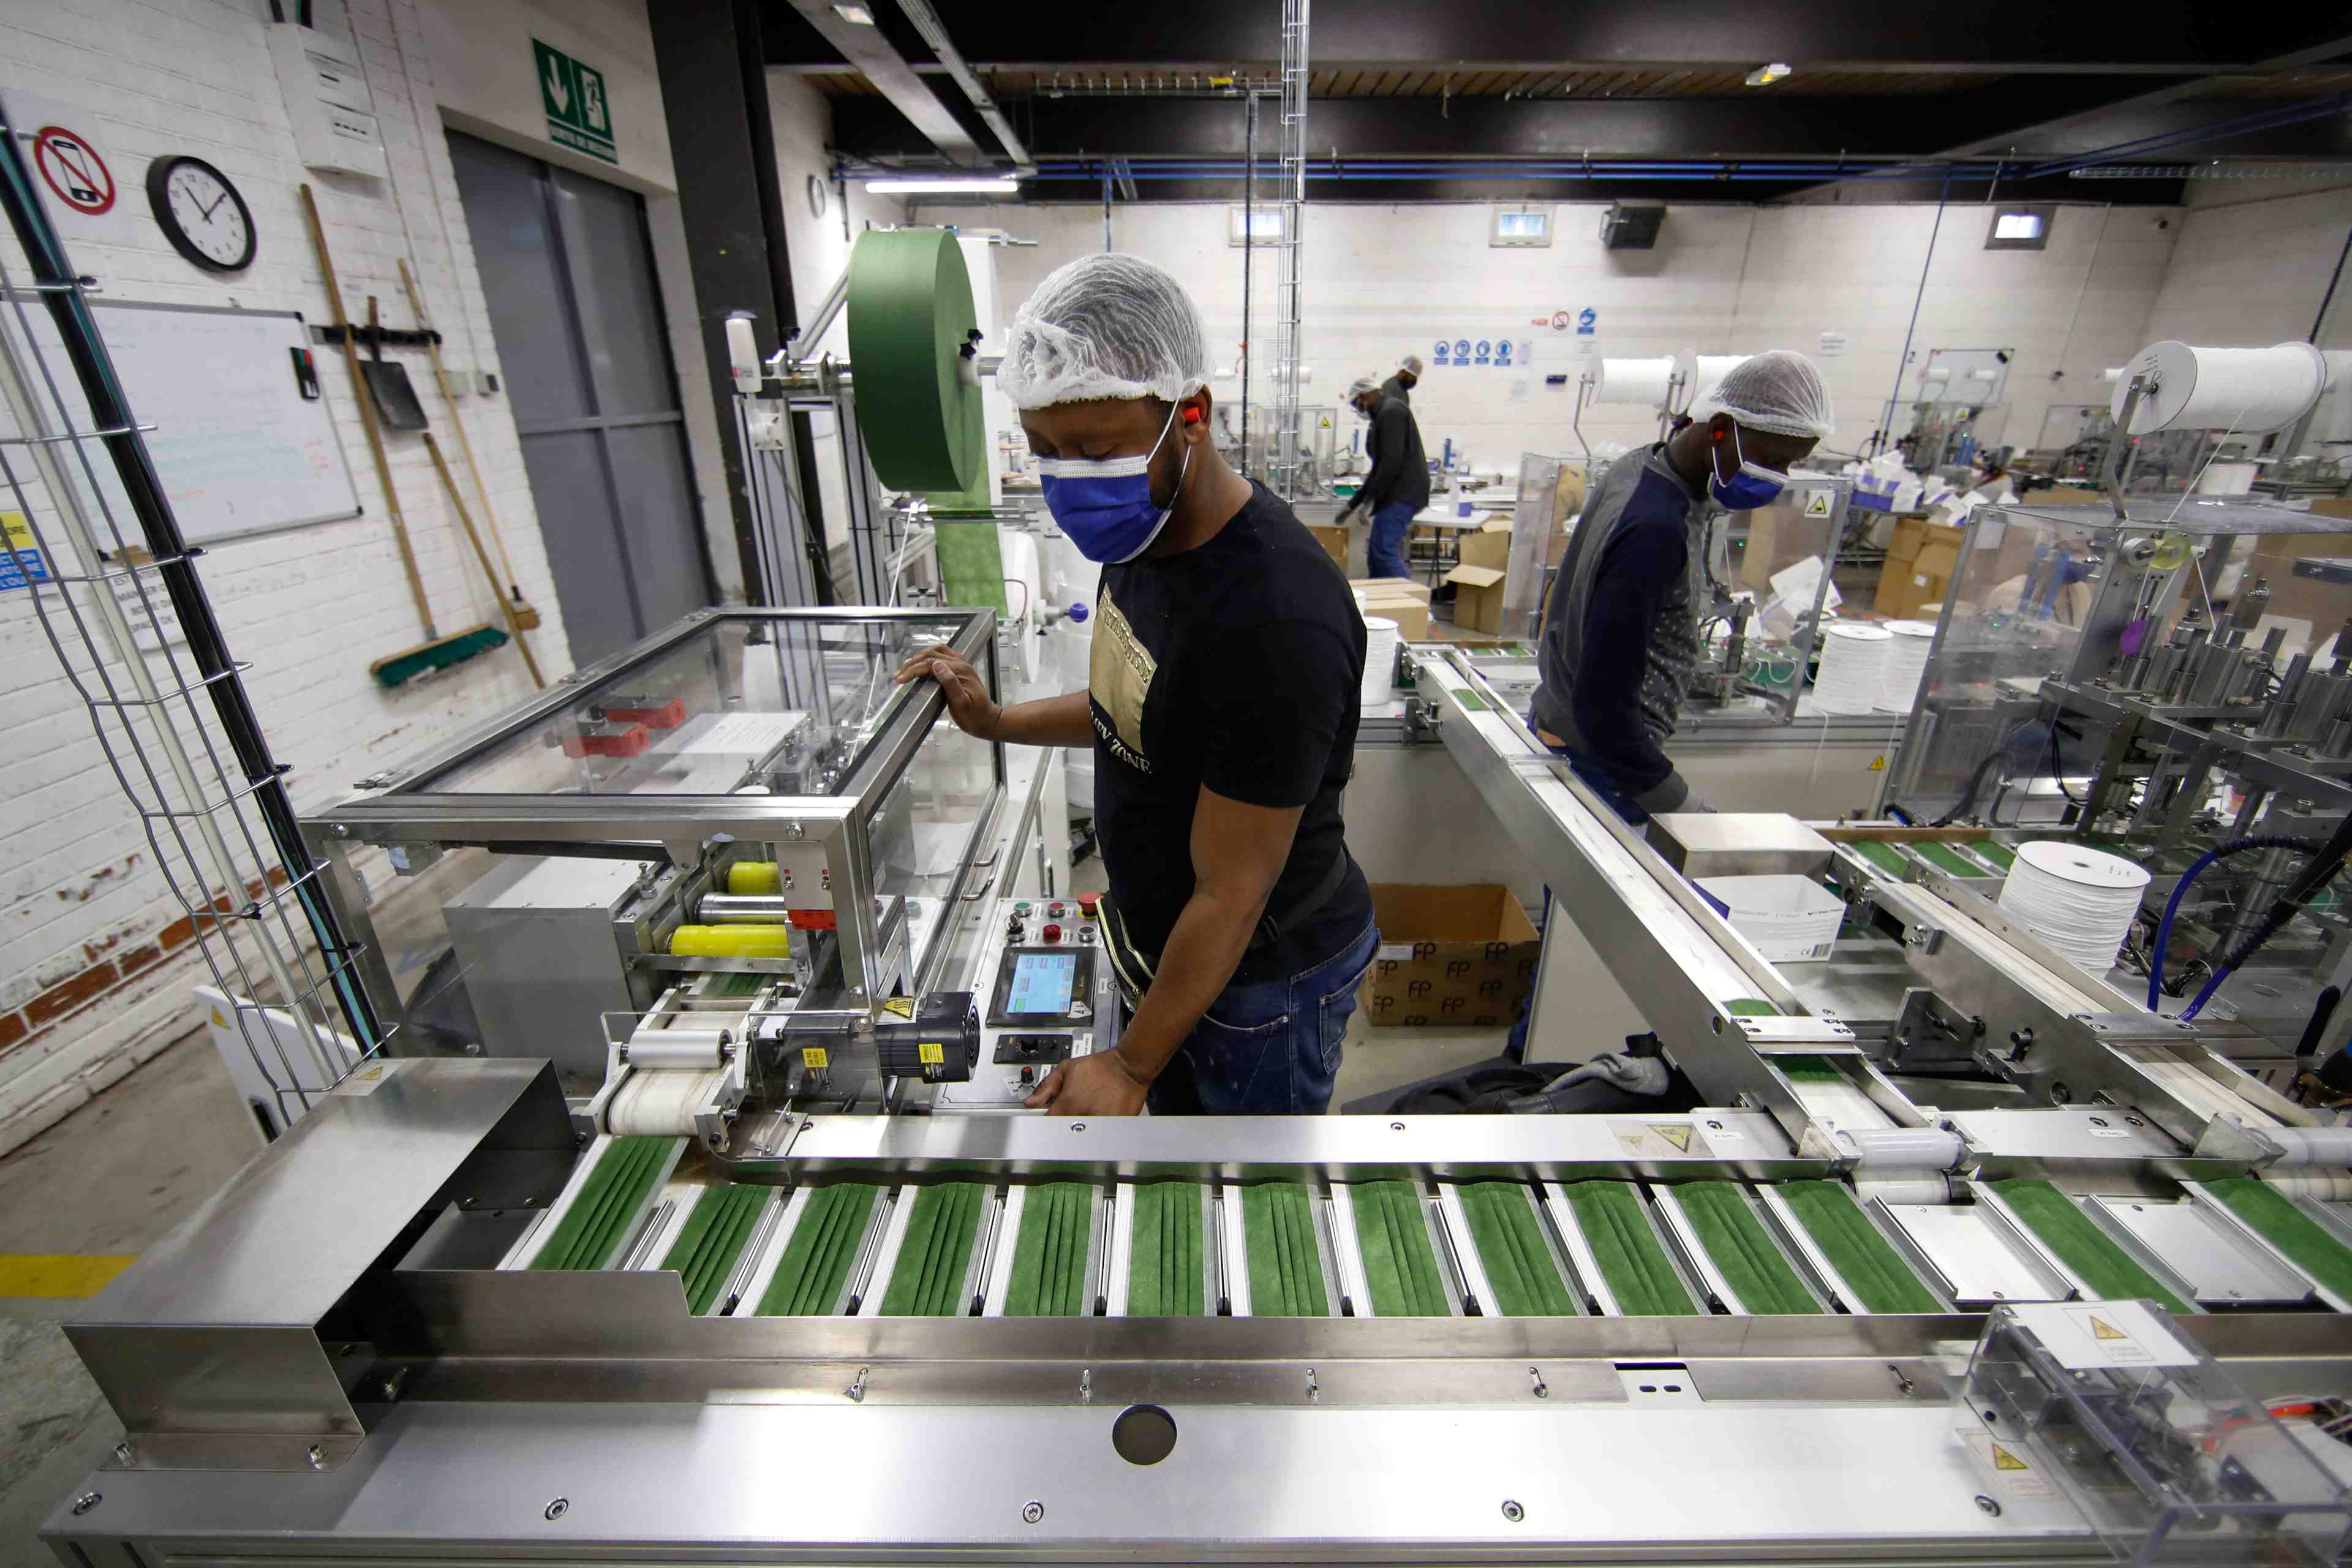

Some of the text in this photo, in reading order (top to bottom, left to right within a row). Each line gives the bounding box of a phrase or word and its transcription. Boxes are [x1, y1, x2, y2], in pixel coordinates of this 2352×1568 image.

[1412, 942, 1436, 961] FP
[1485, 942, 1509, 961] FP
[1447, 961, 1471, 978] FP
[1408, 980, 1432, 997] FP
[1479, 980, 1503, 997] FP
[1441, 997, 1465, 1012] FP
